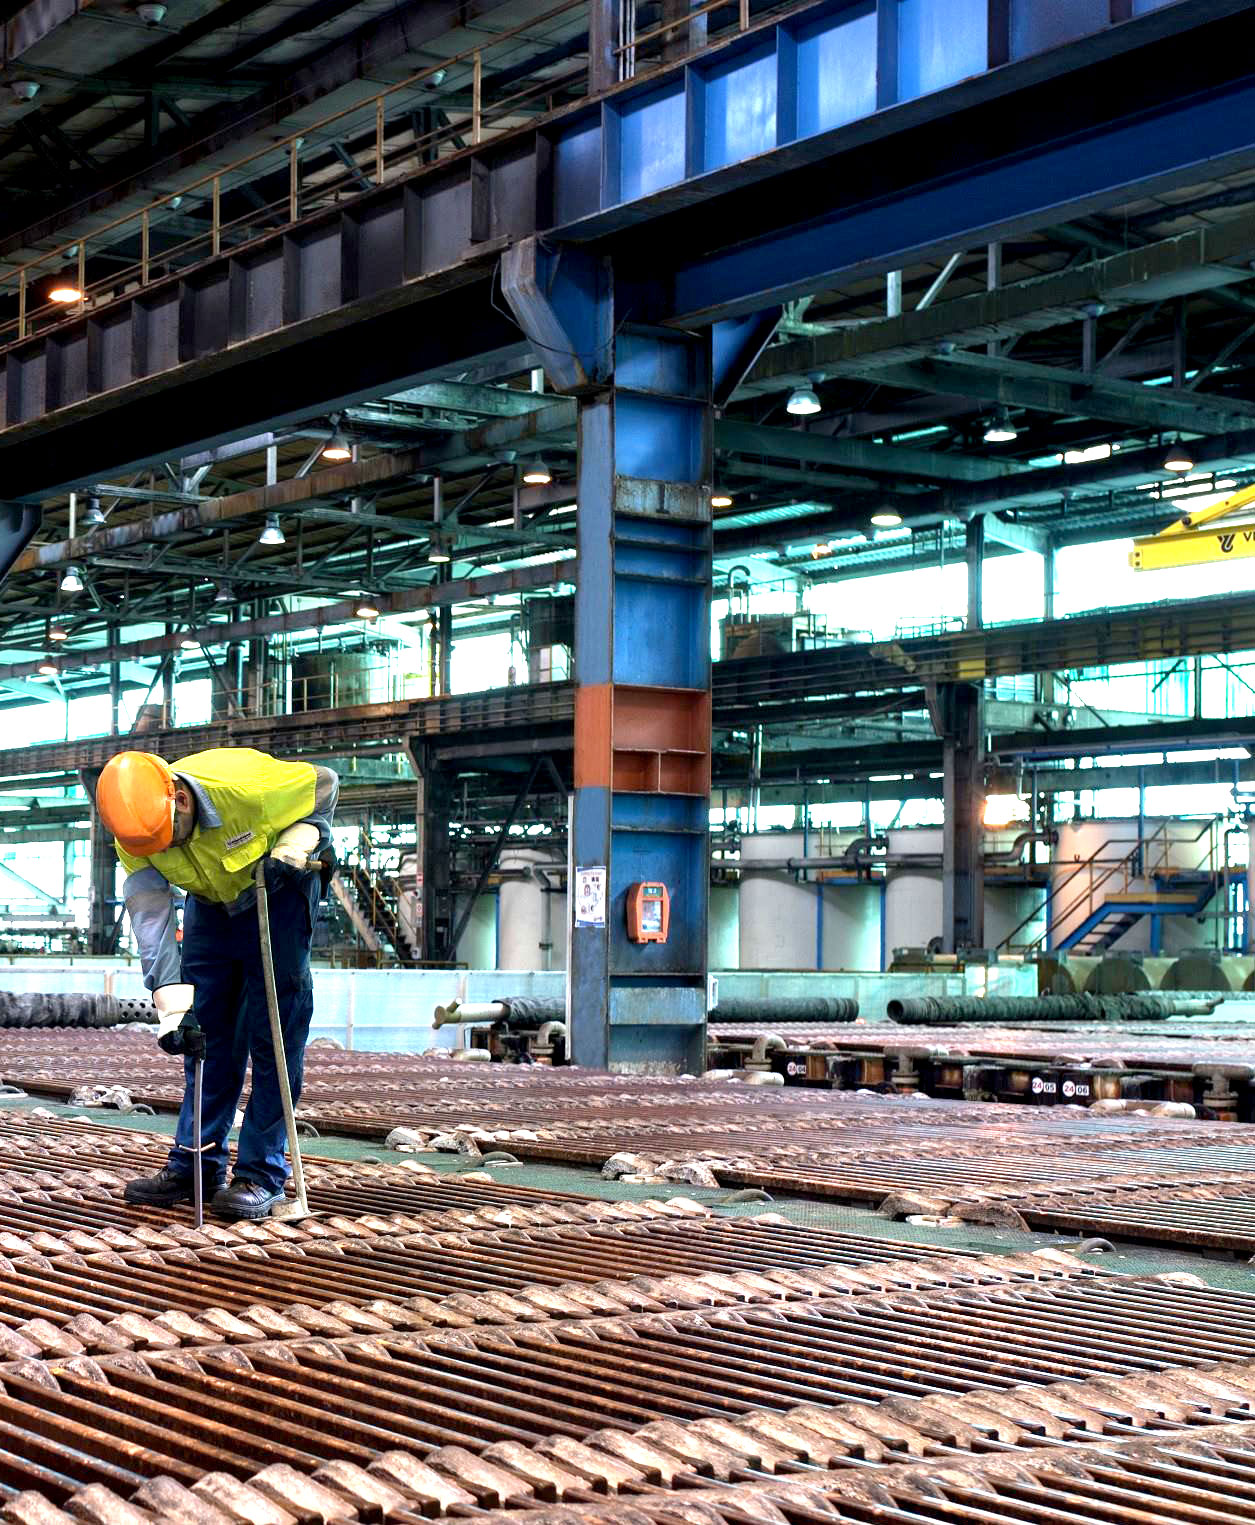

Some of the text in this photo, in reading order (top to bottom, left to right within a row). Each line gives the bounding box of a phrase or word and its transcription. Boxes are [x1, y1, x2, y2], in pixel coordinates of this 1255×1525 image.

[1032, 1081, 1055, 1091] 24 05
[1064, 1084, 1088, 1094] 24 06
